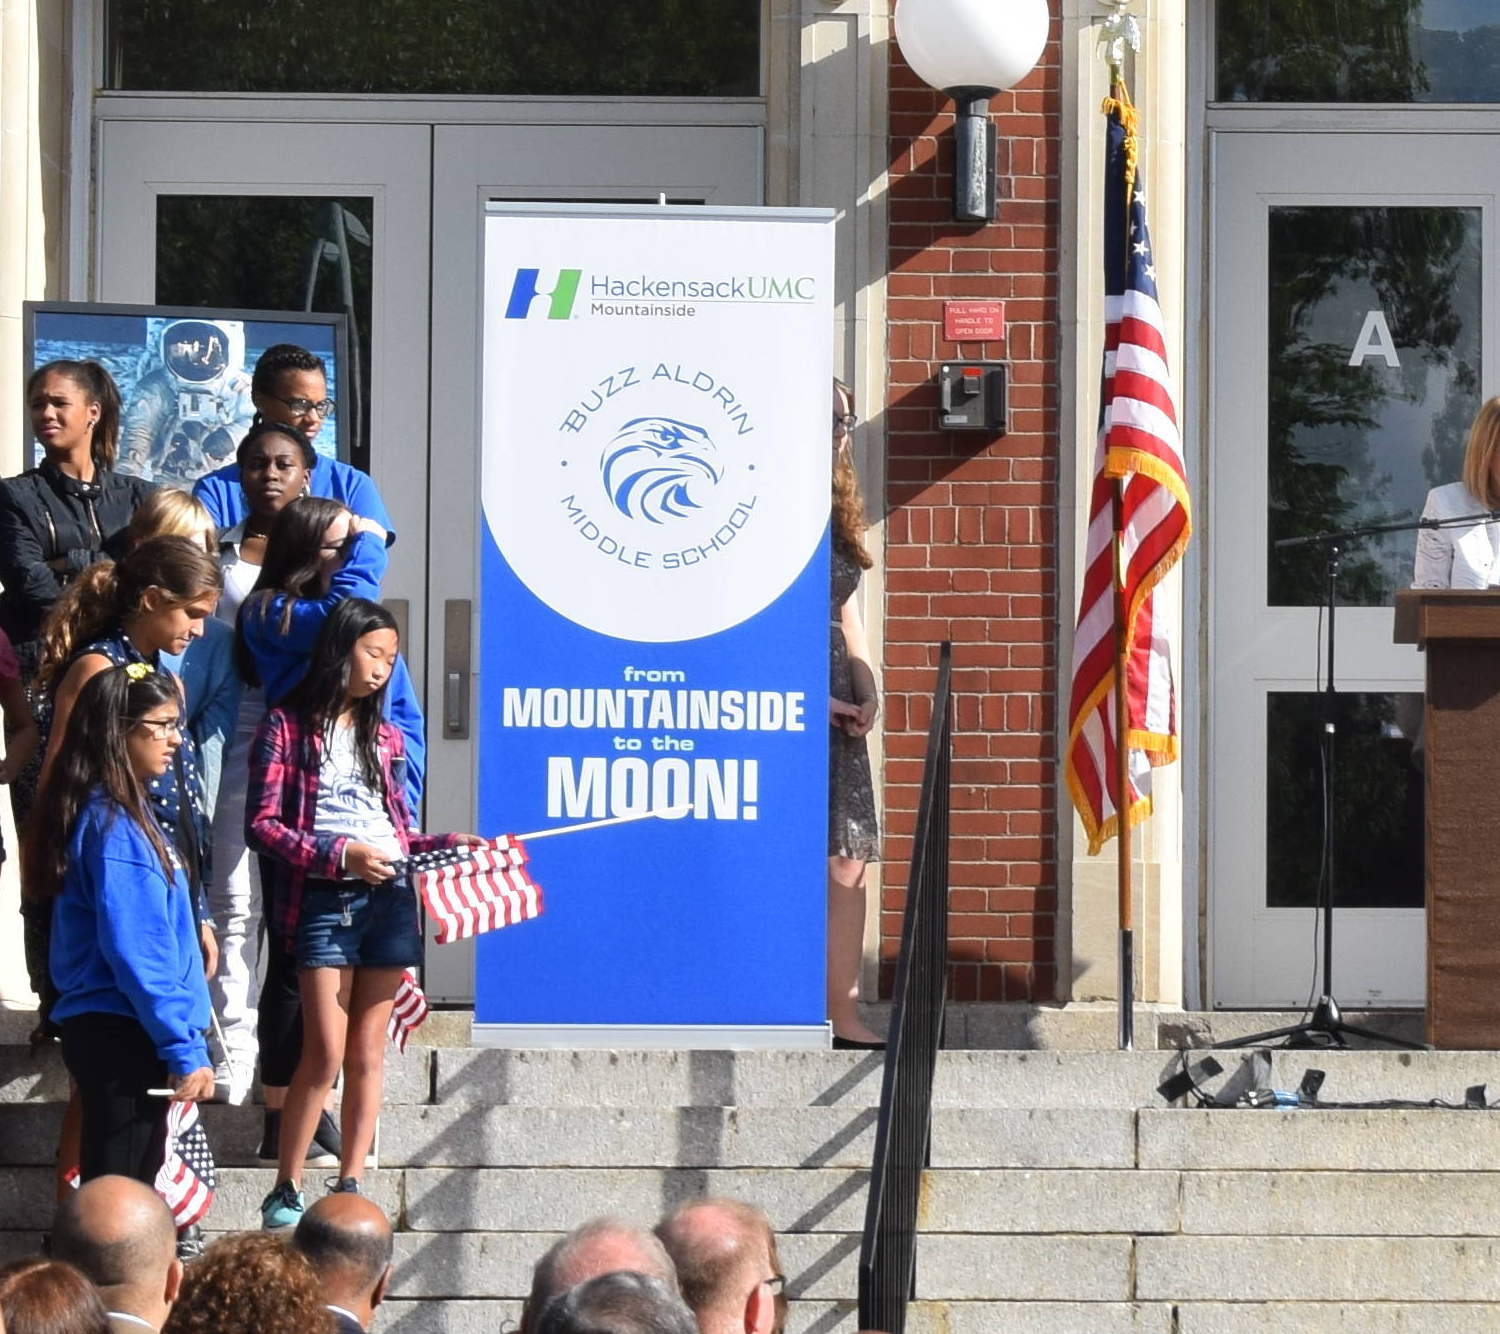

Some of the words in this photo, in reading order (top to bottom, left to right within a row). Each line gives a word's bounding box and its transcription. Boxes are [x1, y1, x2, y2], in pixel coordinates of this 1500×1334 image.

[591, 303, 696, 317] Mountainside
[1349, 311, 1400, 367] A
[559, 367, 640, 433] BUZZ
[651, 363, 754, 435] ALDRIN
[561, 495, 652, 569] MIDDLE
[663, 496, 757, 569] SCHOOL
[623, 665, 686, 683] from
[503, 688, 805, 732] MOUNTAINSIDE
[613, 735, 642, 751] to
[652, 735, 695, 751] the
[547, 757, 758, 822] MOON!
